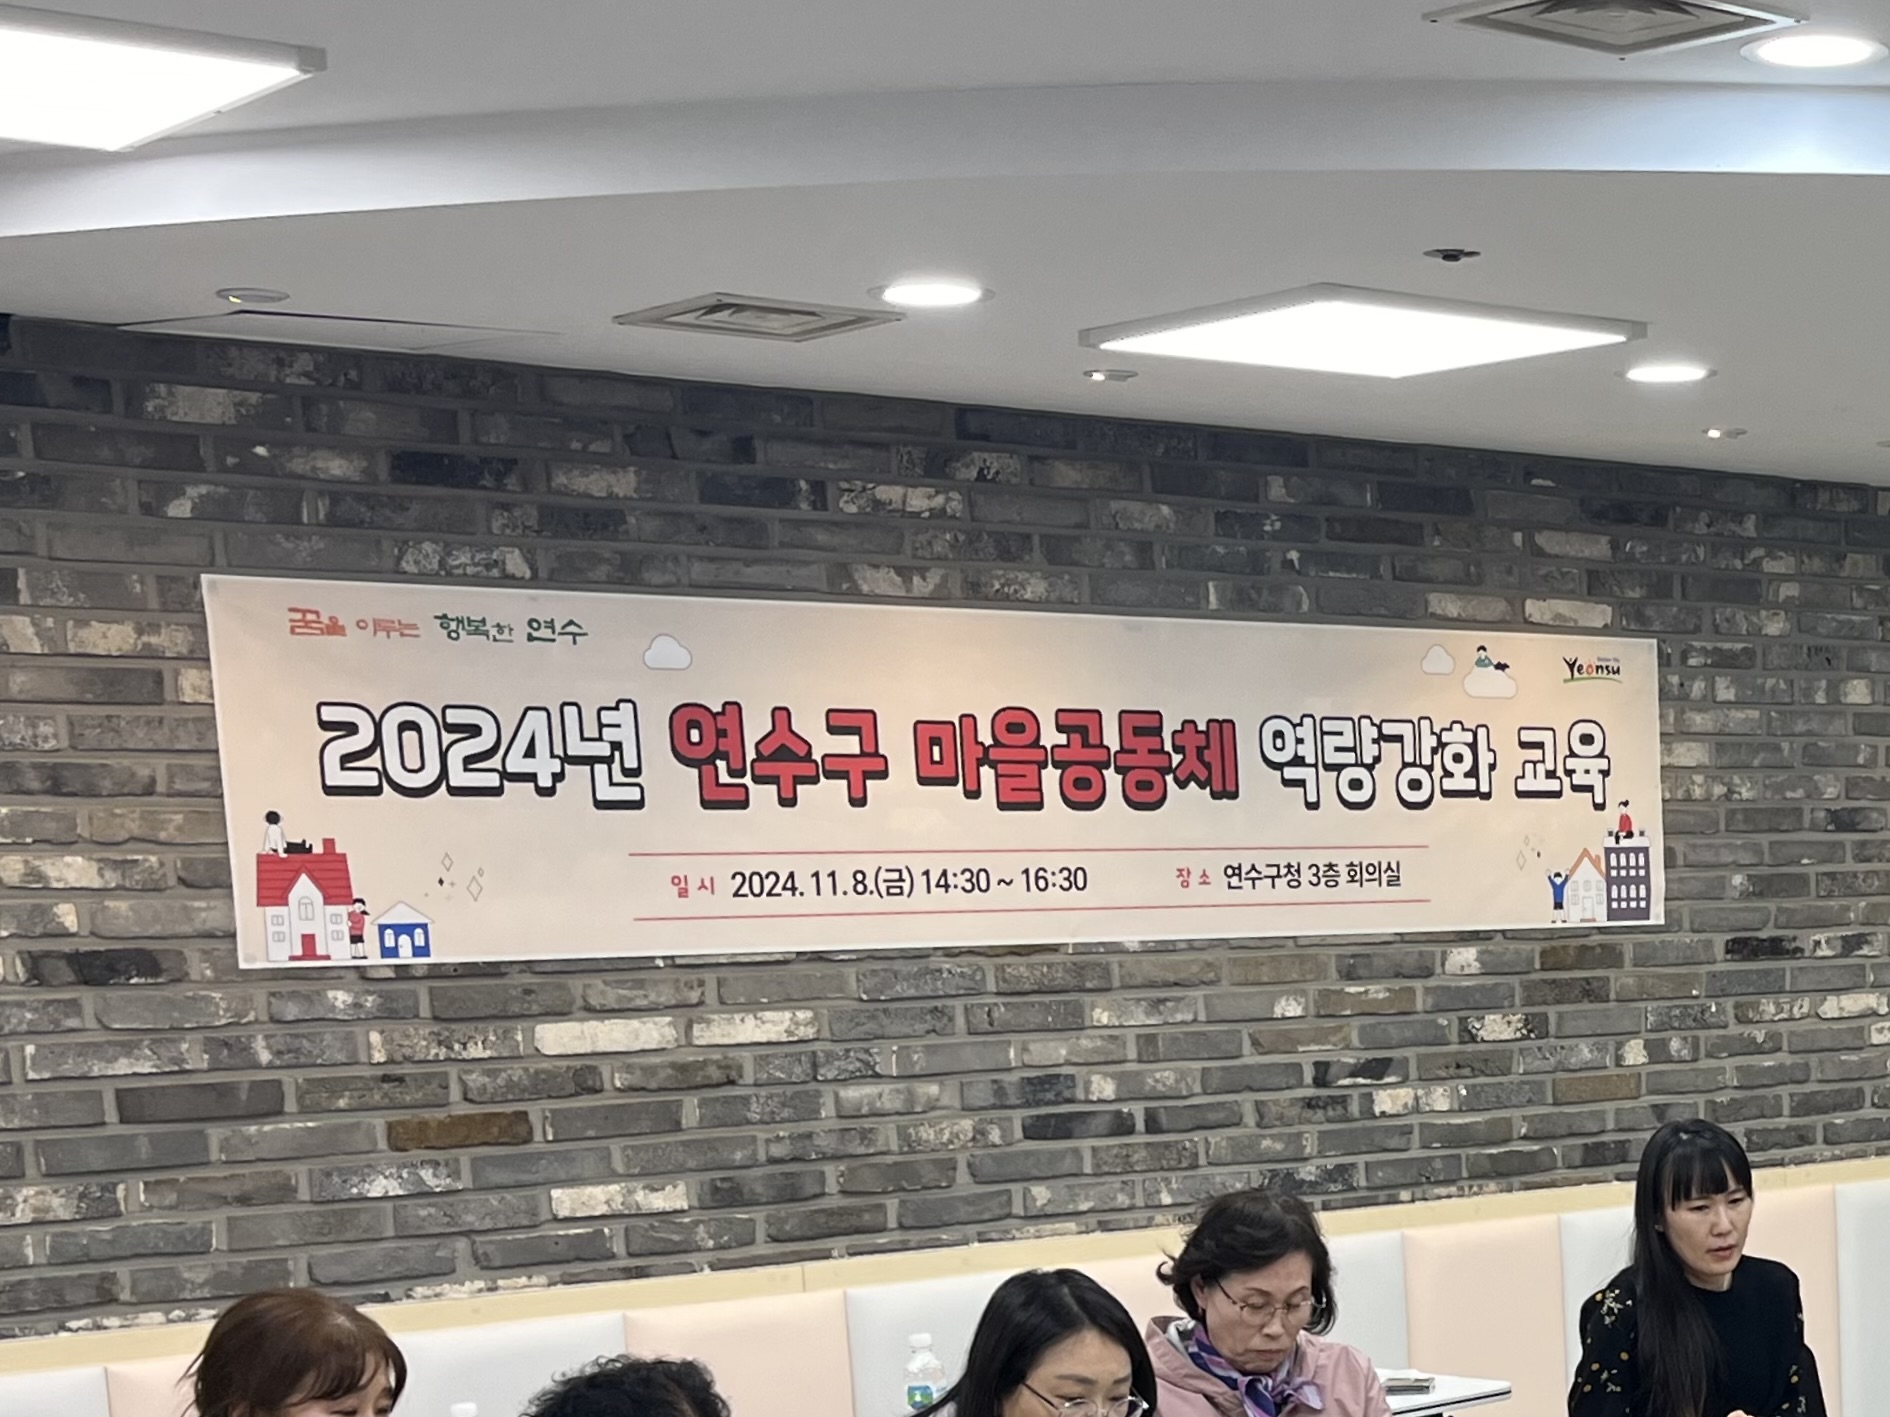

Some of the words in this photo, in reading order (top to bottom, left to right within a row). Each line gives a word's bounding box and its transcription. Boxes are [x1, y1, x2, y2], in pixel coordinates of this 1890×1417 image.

[287, 606, 347, 637] 꿈을
[355, 617, 422, 640] 이루는
[433, 612, 515, 643] 행복한
[526, 617, 589, 645] 연수
[1562, 656, 1621, 680] Yeonsu
[315, 698, 645, 811] 2024년
[669, 701, 889, 810] 연수구
[912, 703, 1240, 812] 마을공동체
[1259, 712, 1498, 811] 역량강화
[1514, 718, 1611, 811] 교육
[922, 868, 991, 894] 14:30
[1022, 867, 1088, 893] 16:30
[1223, 861, 1301, 890] 연수구청
[1308, 862, 1341, 888] 3층
[1346, 860, 1401, 888] 회의실
